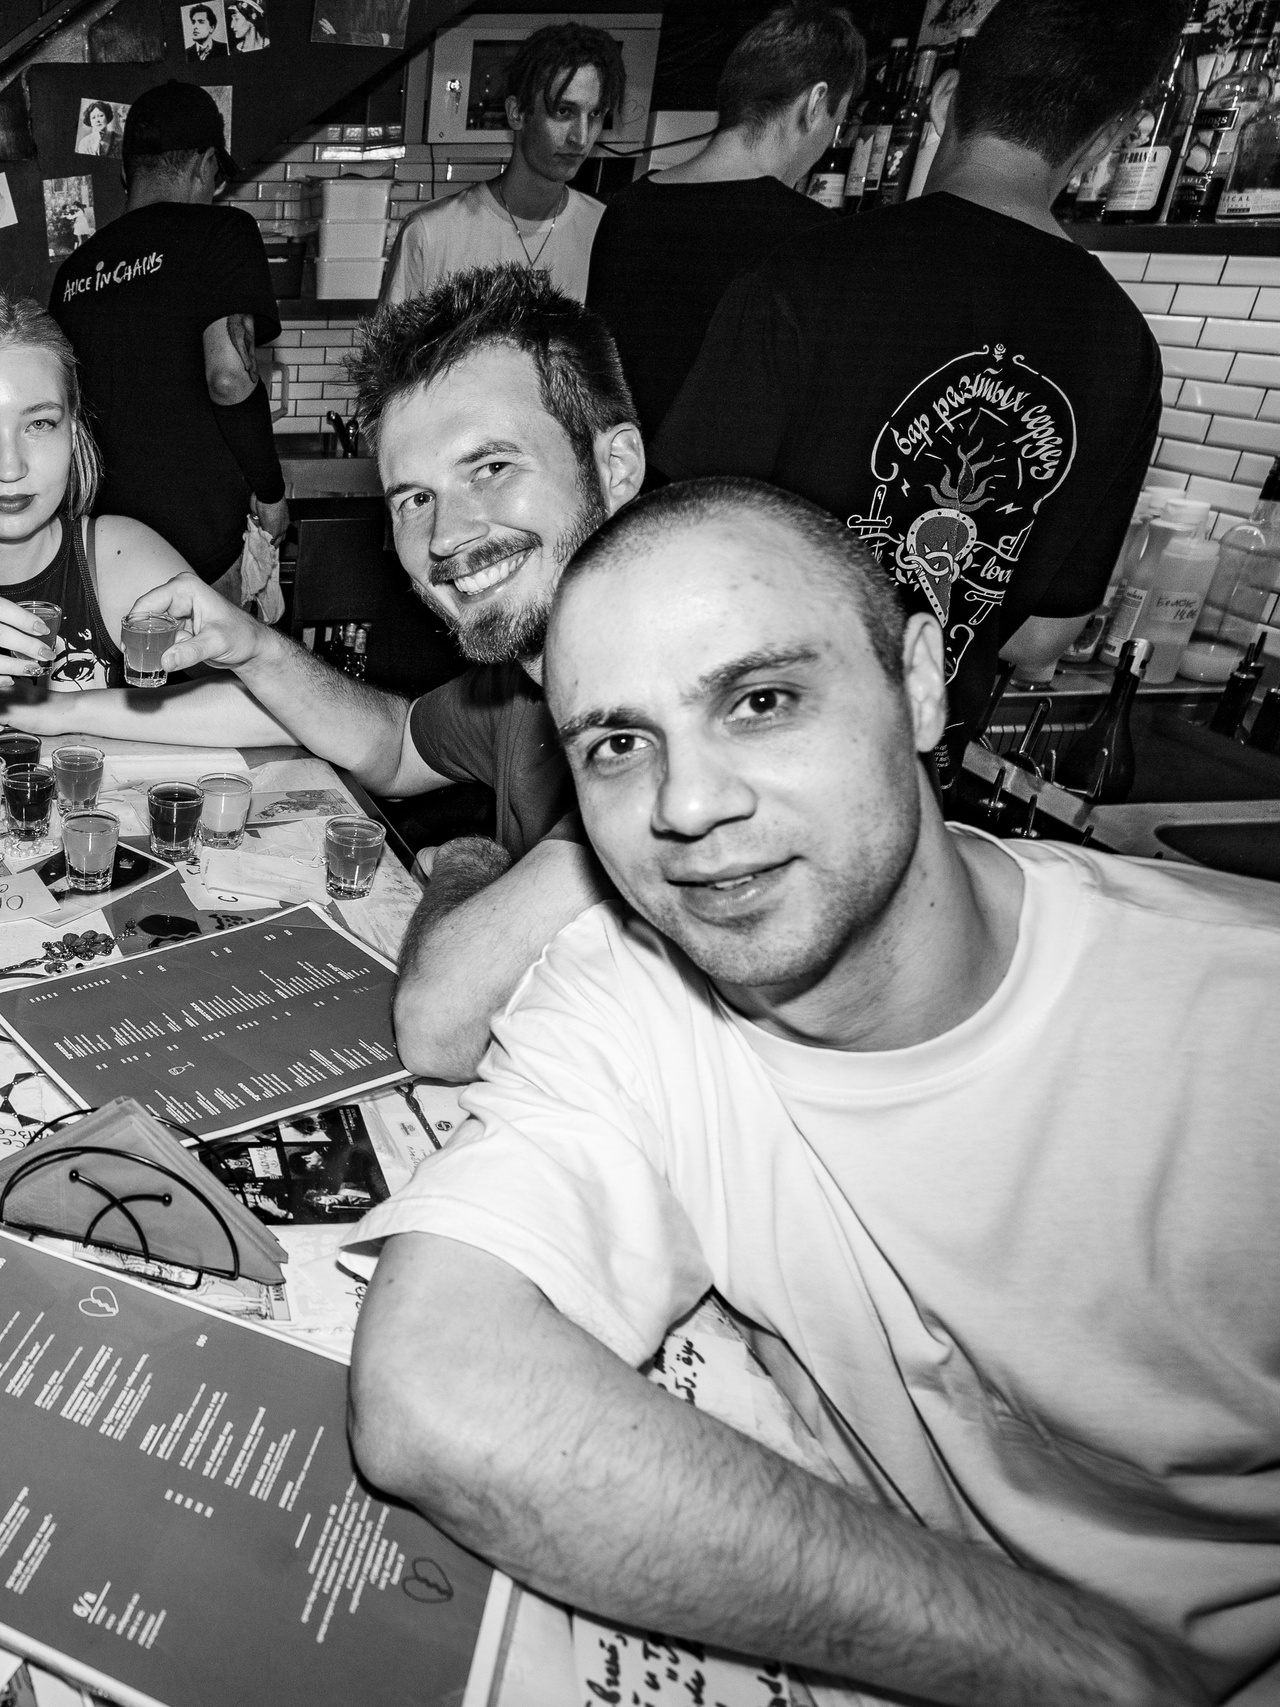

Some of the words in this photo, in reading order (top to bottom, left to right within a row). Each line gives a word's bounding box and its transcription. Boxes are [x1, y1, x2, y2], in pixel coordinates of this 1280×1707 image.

[63, 276, 92, 302] ALICE
[94, 260, 111, 293] IN
[111, 251, 164, 285] CHAINS
